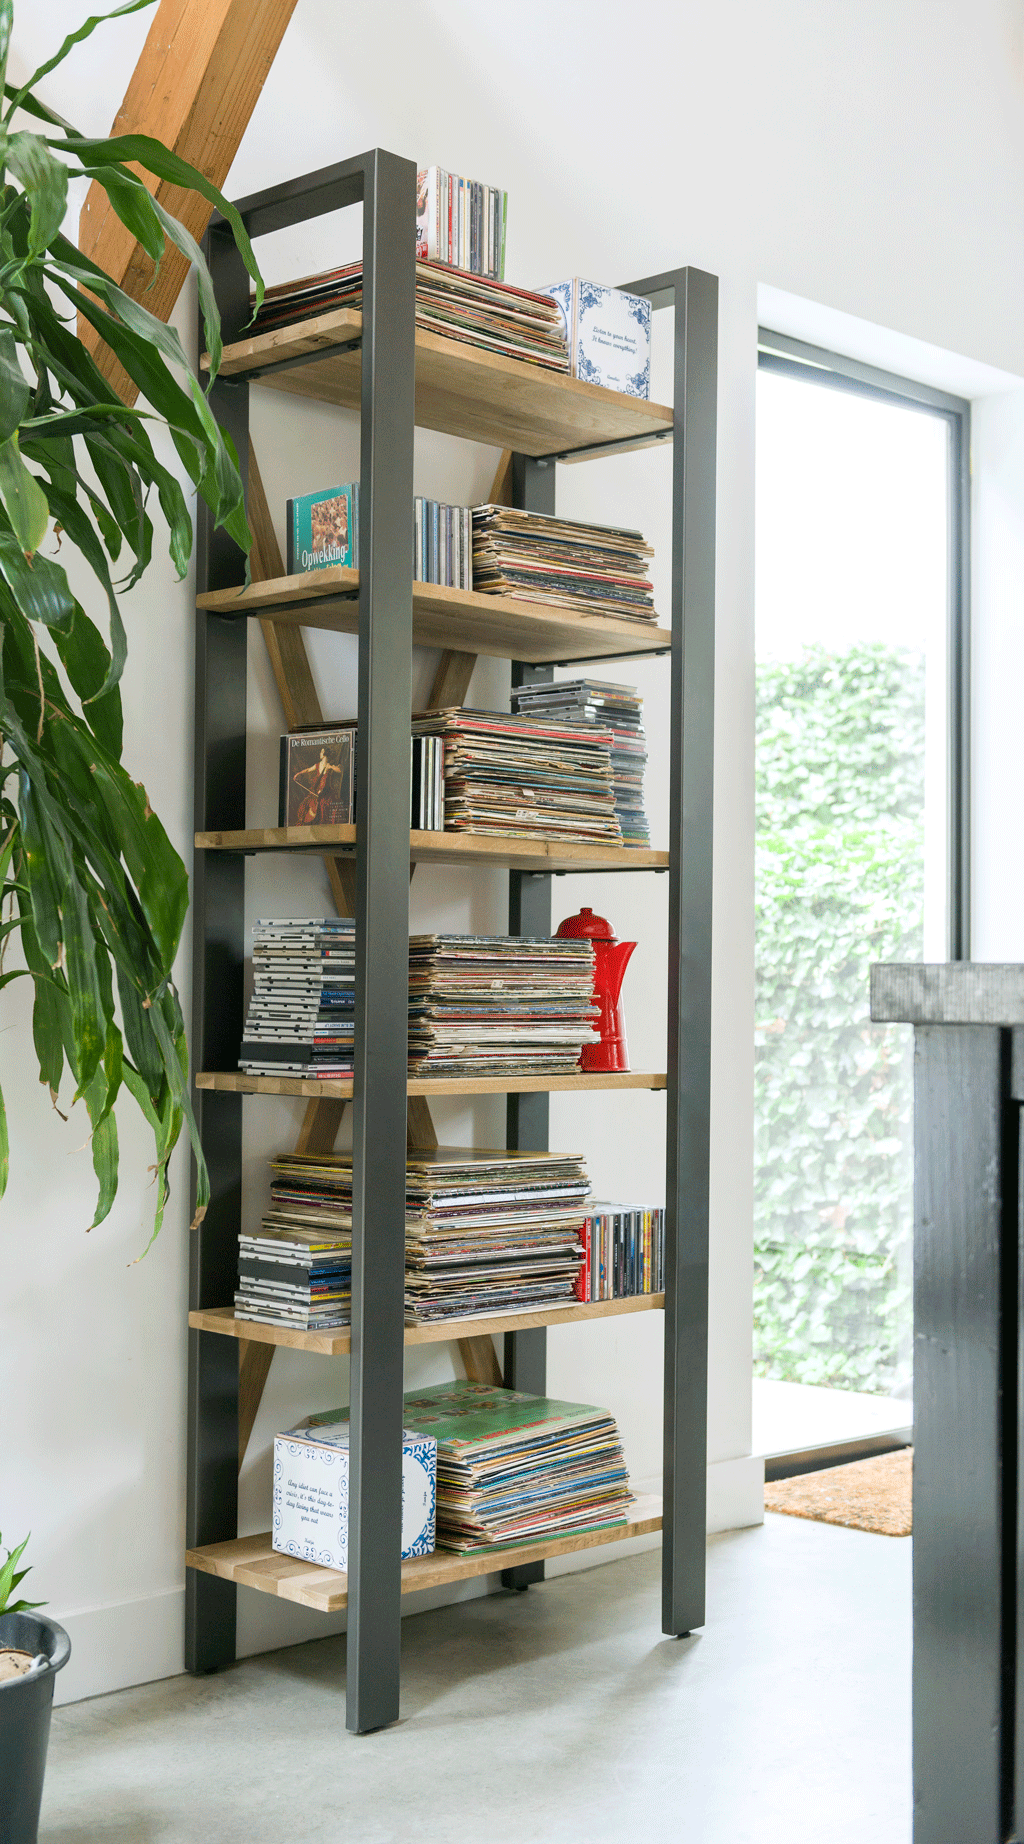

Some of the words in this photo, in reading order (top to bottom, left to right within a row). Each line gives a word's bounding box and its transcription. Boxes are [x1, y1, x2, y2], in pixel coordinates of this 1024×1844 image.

[292, 740, 300, 748] De
[300, 736, 335, 747] Romantische
[336, 734, 349, 744] Cello
